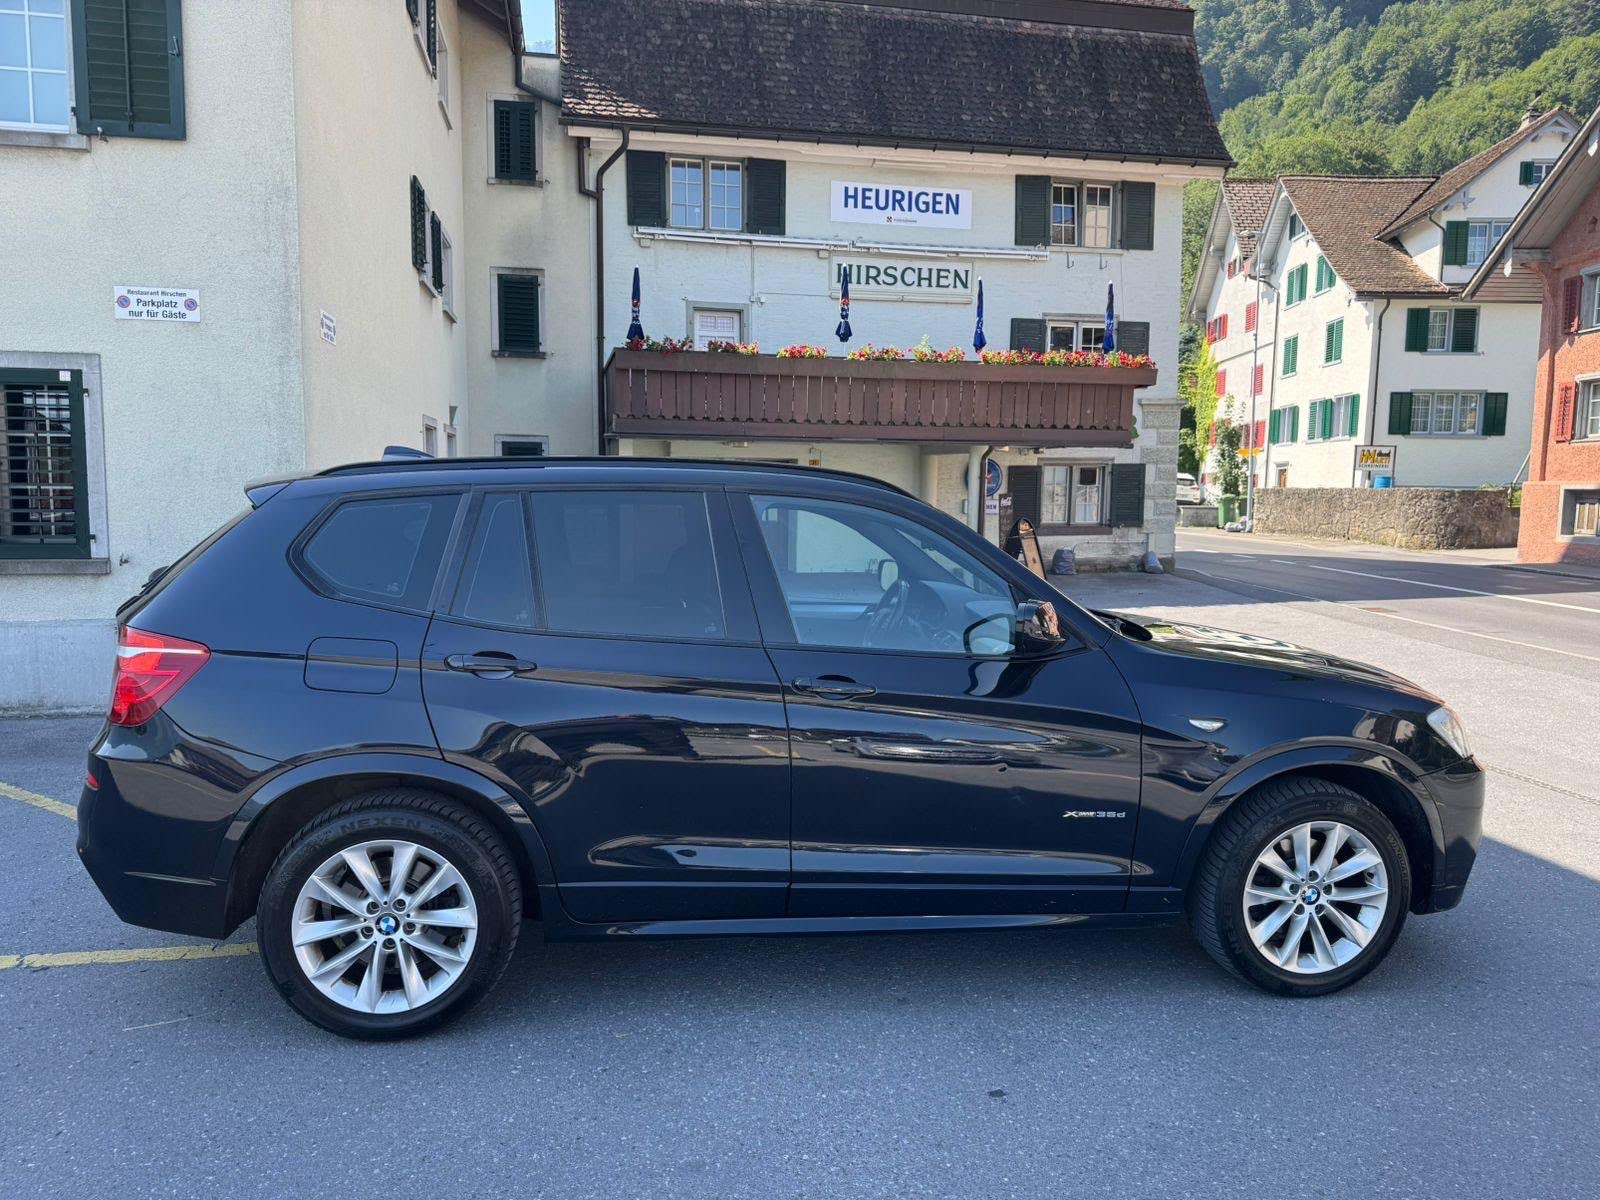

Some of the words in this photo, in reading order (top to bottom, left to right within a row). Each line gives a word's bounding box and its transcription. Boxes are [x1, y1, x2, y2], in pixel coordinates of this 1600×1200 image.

[843, 186, 960, 215] HEURIGEN
[836, 263, 970, 290] HIRSCHEN
[127, 289, 160, 297] Restaurant
[161, 290, 187, 298] Hirschen
[136, 298, 178, 309] Parkplatz
[128, 310, 144, 318] nur
[146, 309, 160, 318] für
[161, 310, 187, 320] Gäste
[340, 815, 422, 834] NEXEN
